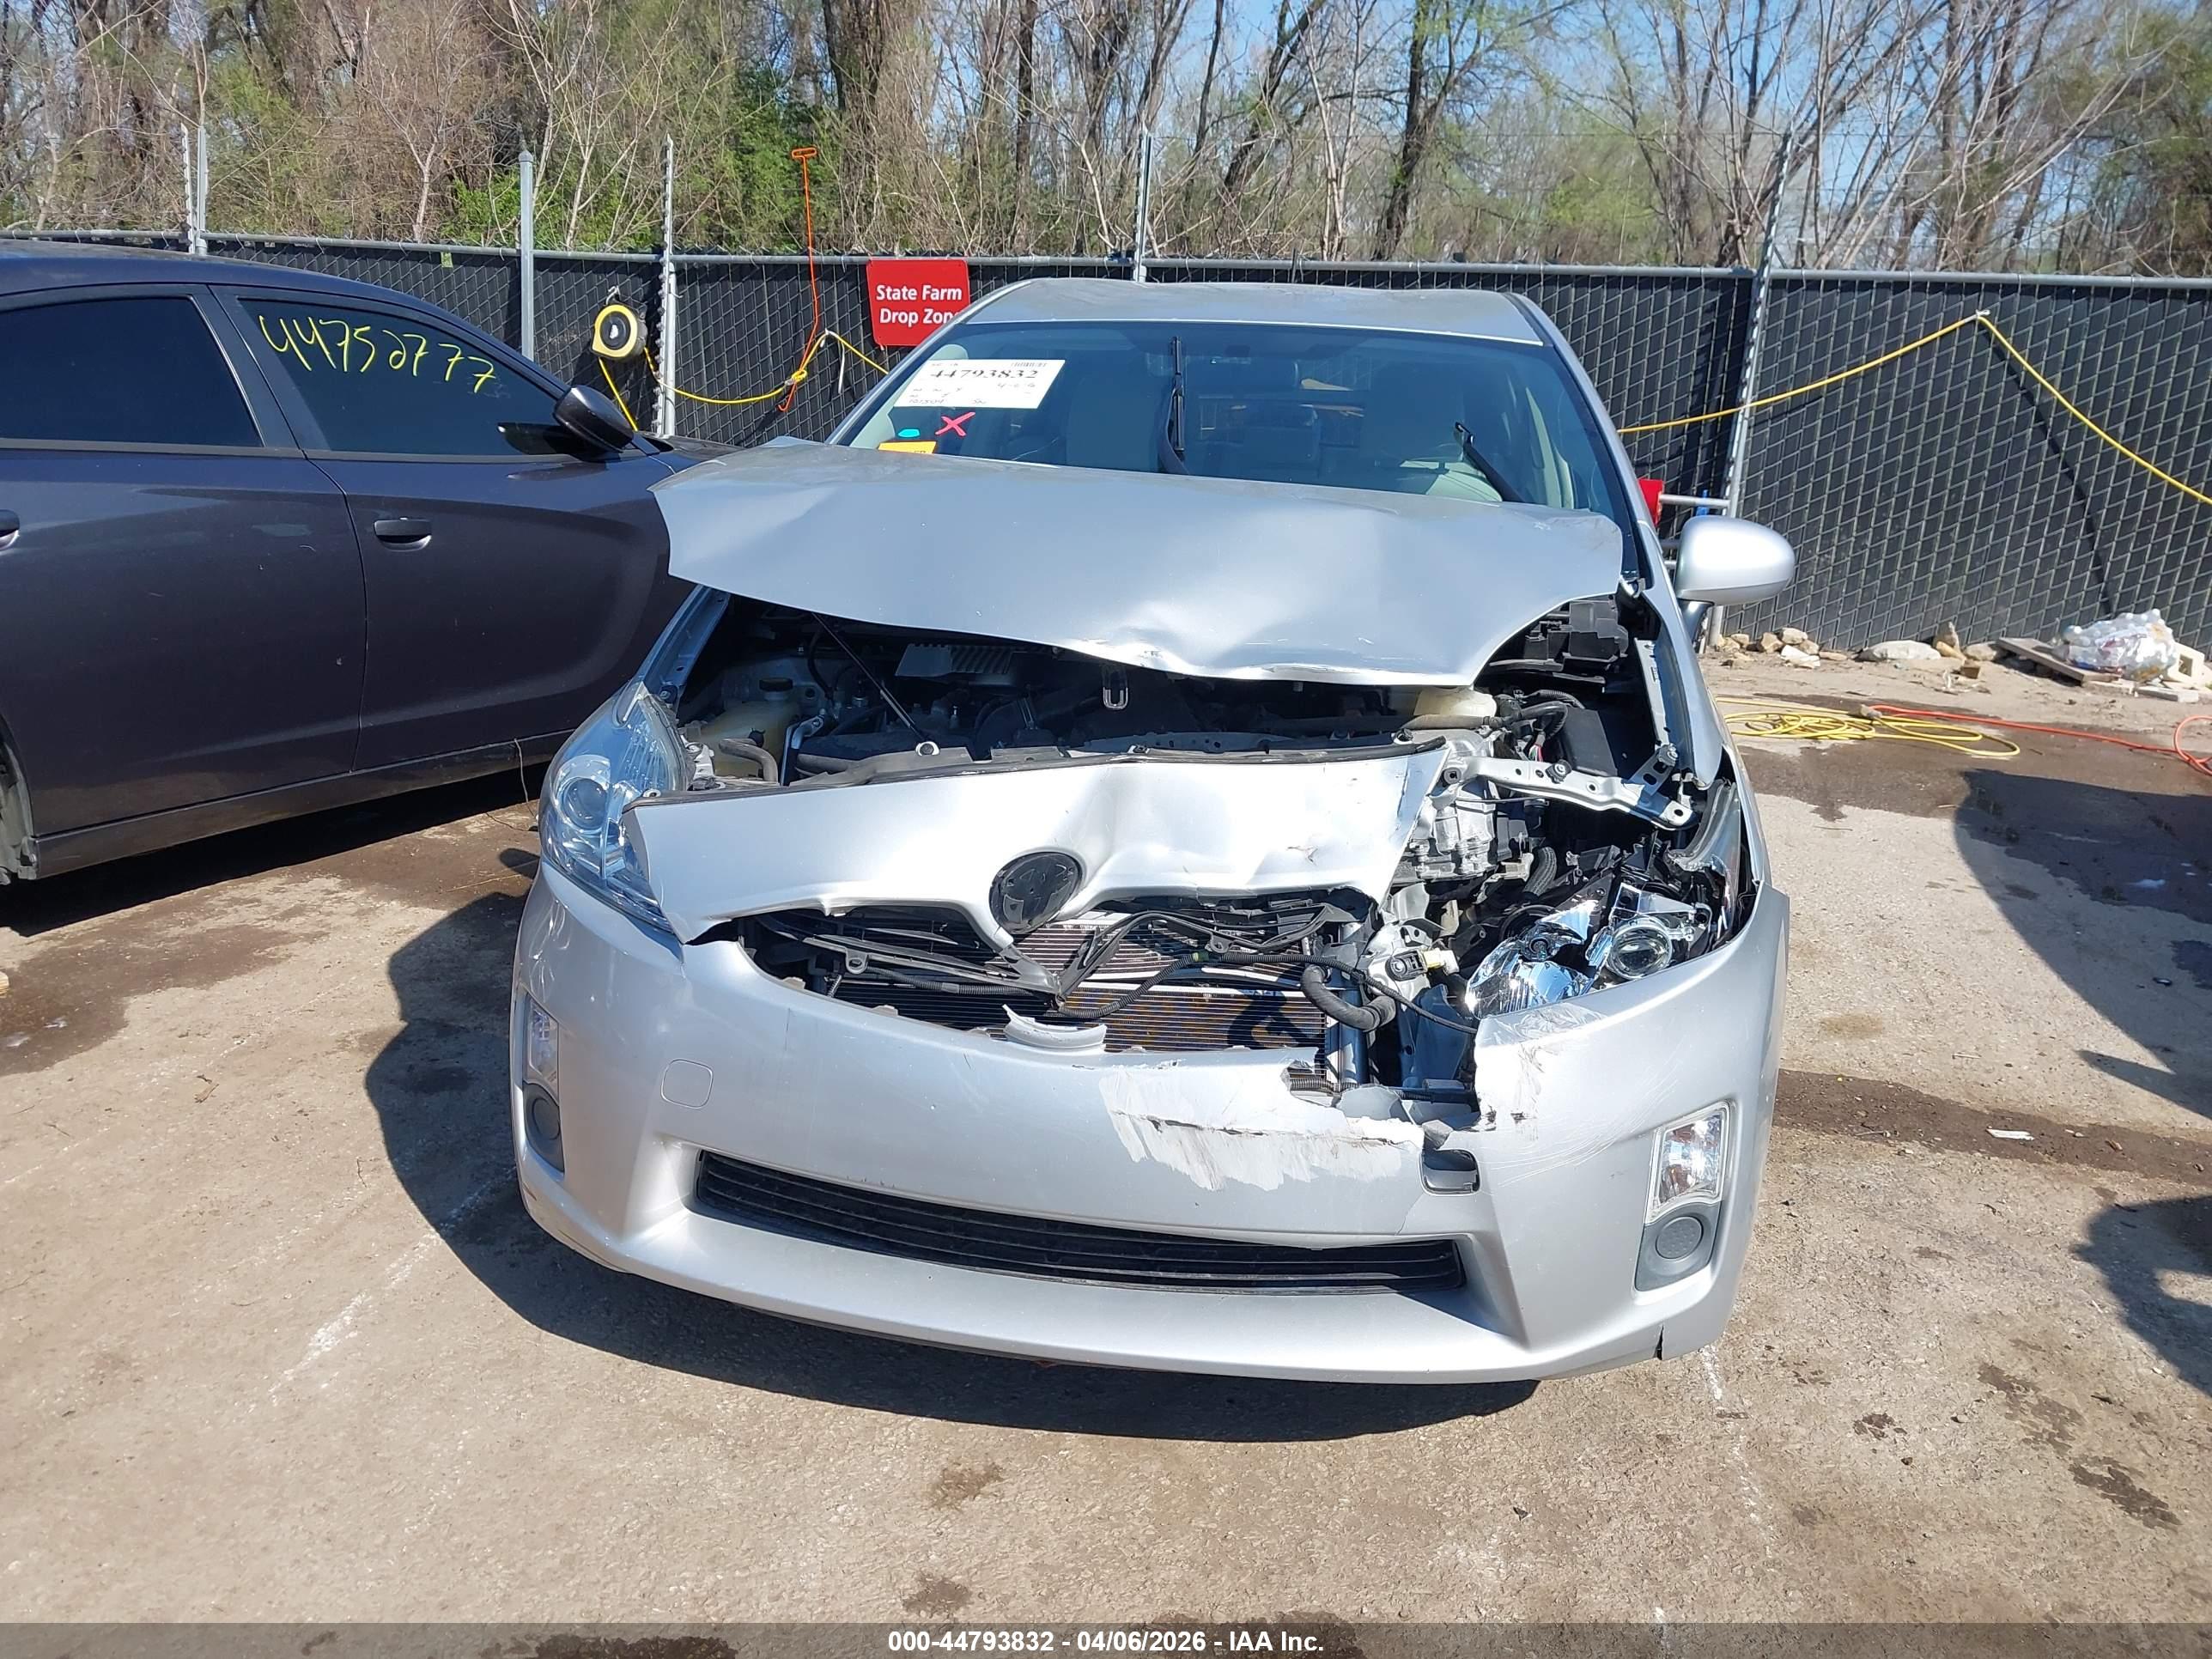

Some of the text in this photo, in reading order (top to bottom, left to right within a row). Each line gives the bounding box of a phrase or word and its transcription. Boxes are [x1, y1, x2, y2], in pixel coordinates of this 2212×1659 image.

[876, 284, 962, 301] State Farm
[879, 308, 959, 327] Drop Zon
[930, 369, 1038, 379] 44793832
